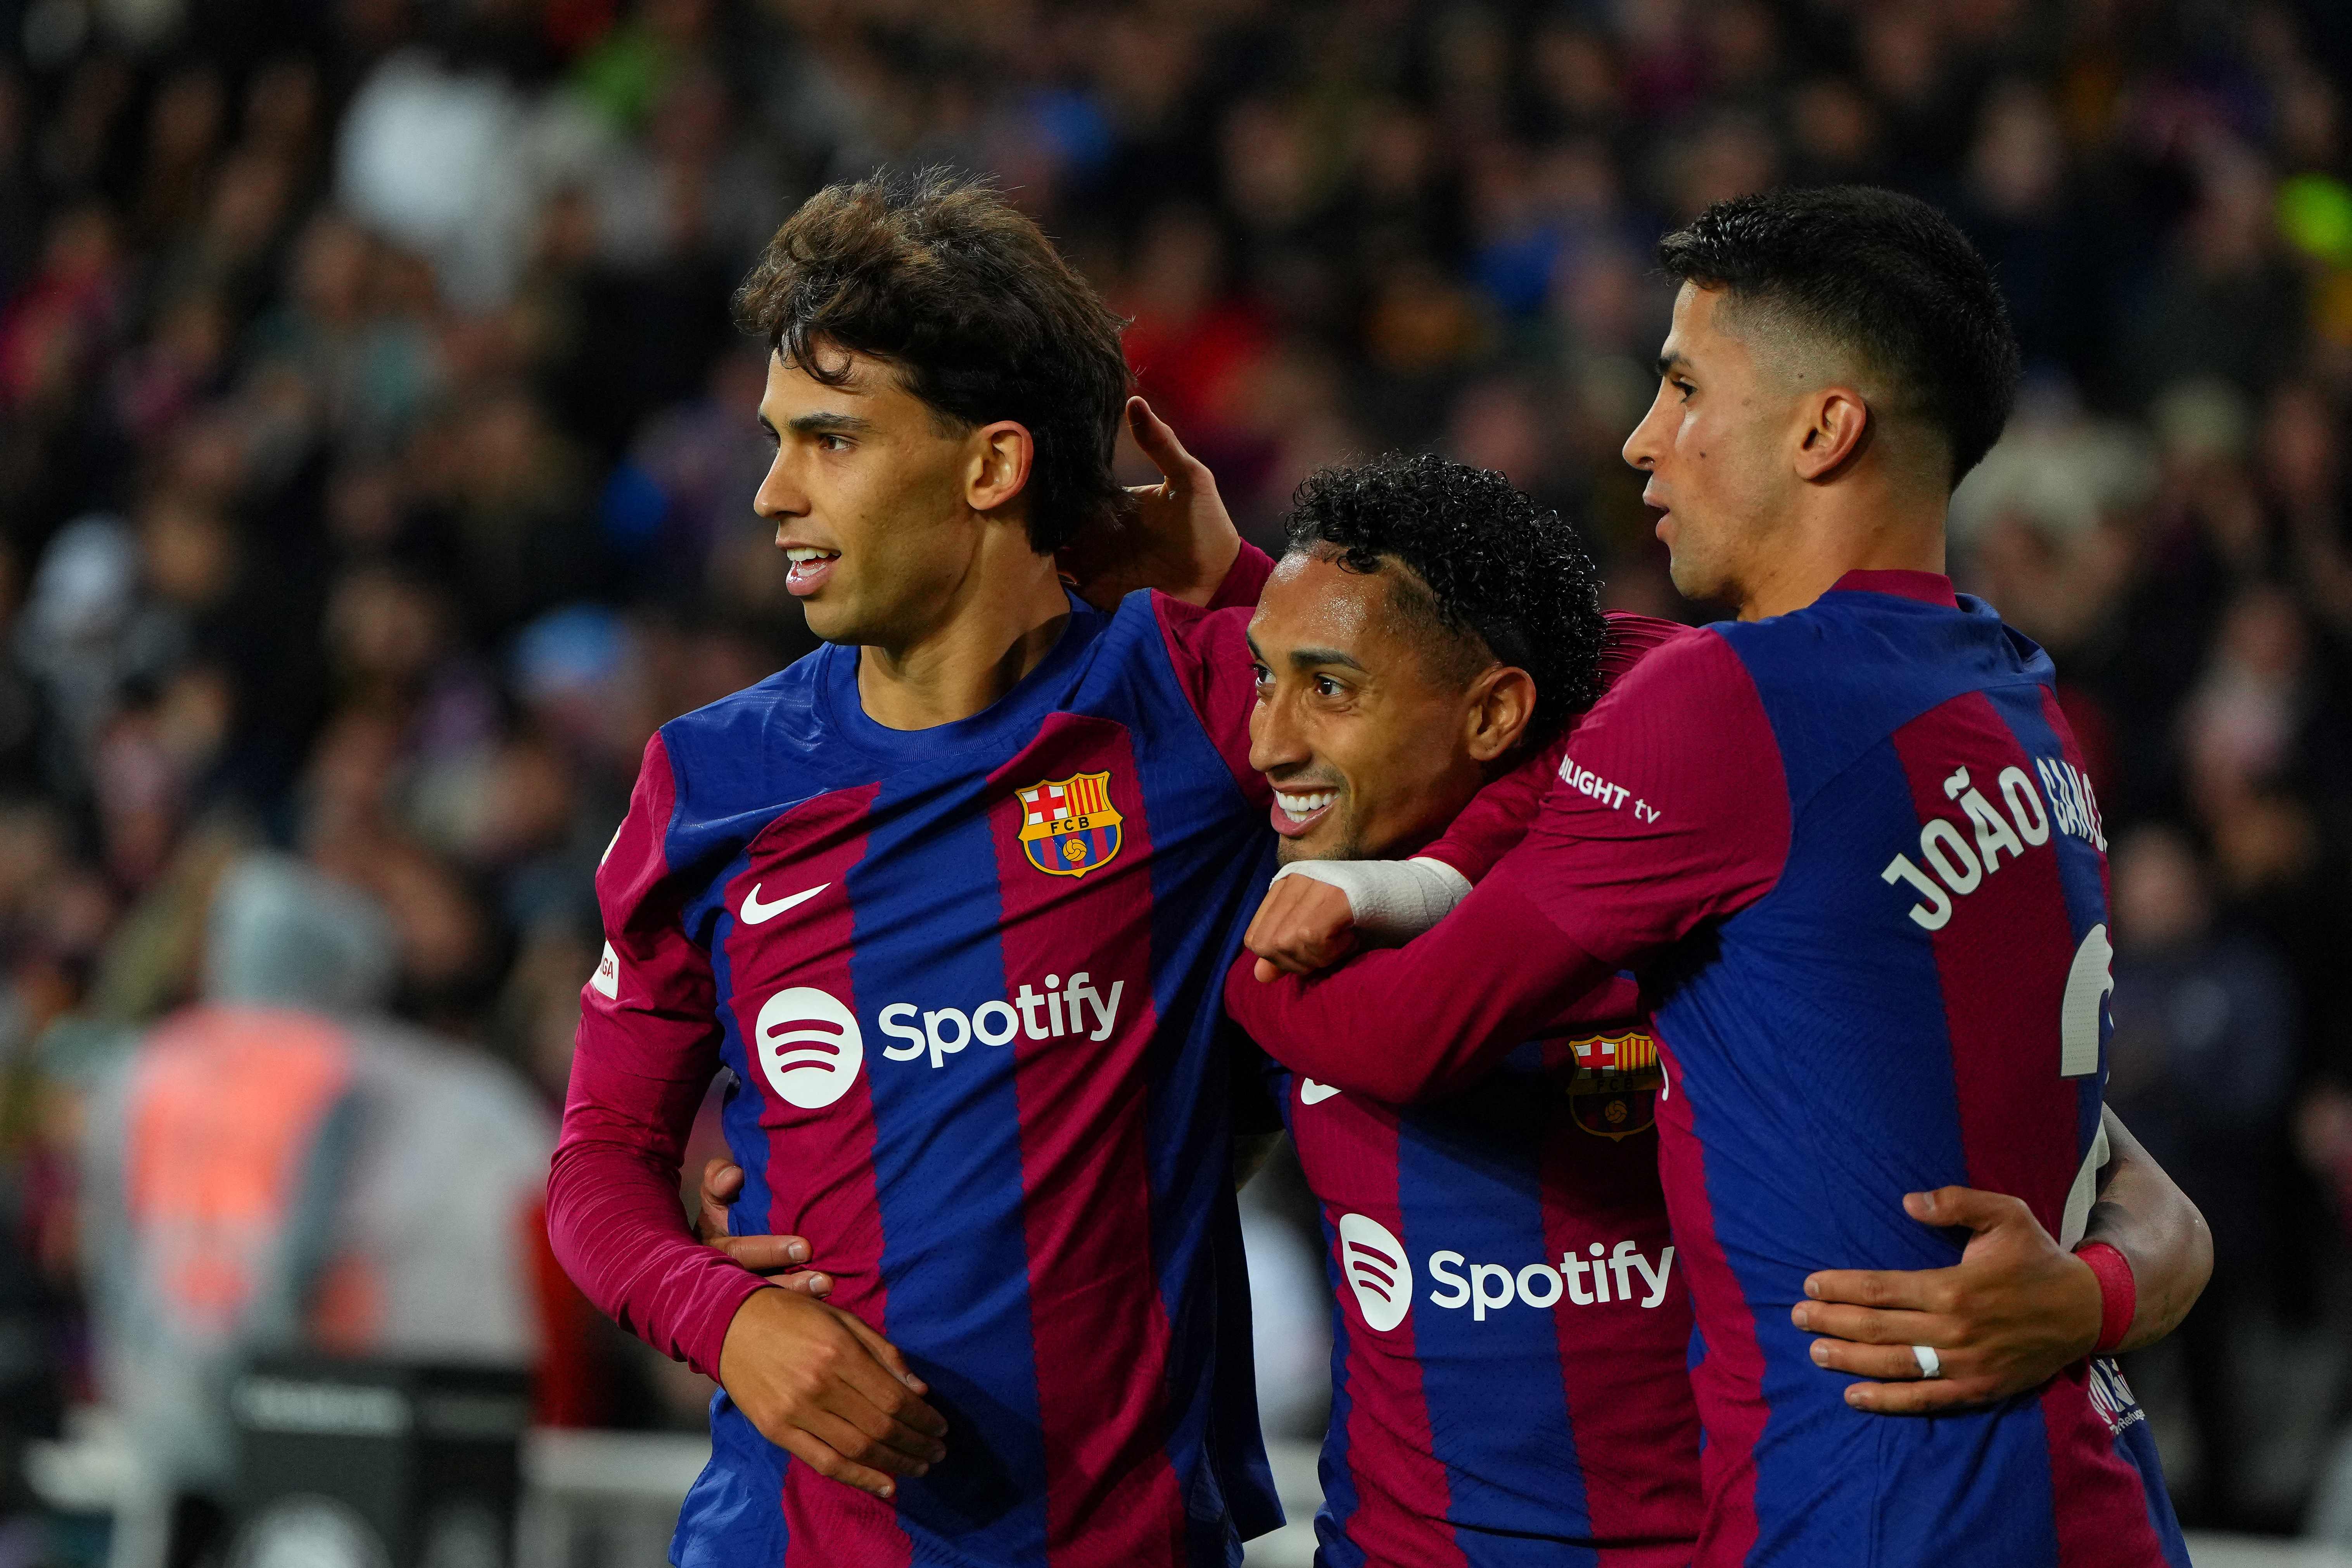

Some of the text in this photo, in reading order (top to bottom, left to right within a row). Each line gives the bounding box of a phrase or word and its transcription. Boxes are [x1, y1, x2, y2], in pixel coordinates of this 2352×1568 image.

[1051, 817, 1089, 834] FCB
[1635, 799, 1661, 825] tv
[1881, 756, 2108, 931] JOÃO CANC
[878, 972, 1125, 1069] Spotify
[1596, 1076, 1633, 1093] FCB
[1428, 1240, 1675, 1322] Spotify
